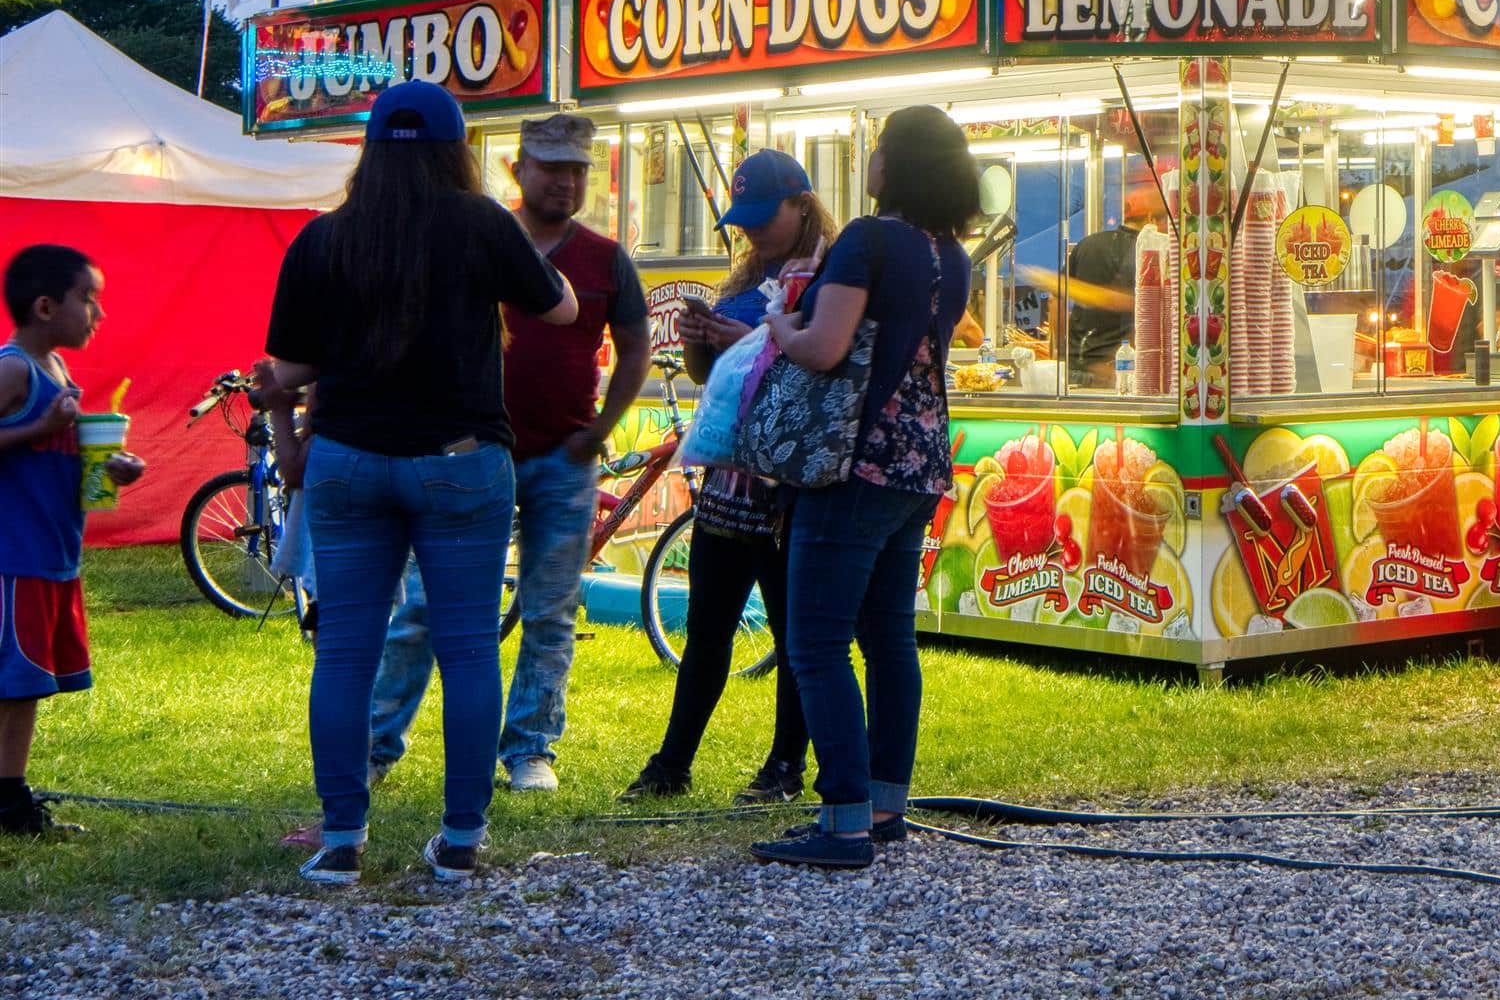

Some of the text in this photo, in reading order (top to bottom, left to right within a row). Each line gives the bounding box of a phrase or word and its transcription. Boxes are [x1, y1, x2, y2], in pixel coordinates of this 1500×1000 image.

[290, 3, 503, 101] JUMBO
[1434, 217, 1463, 231] CHERRY
[1294, 243, 1331, 262] ICED
[1431, 233, 1469, 249] LIMEADE
[1302, 264, 1328, 279] TEA
[650, 283, 675, 307] FRESH
[1007, 553, 1048, 577] Cherry
[1388, 544, 1444, 571] Fresh Brewed
[994, 570, 1060, 600] LIMEADE
[1377, 563, 1454, 593] ICED TEA
[1088, 573, 1157, 619] ICED TEA
